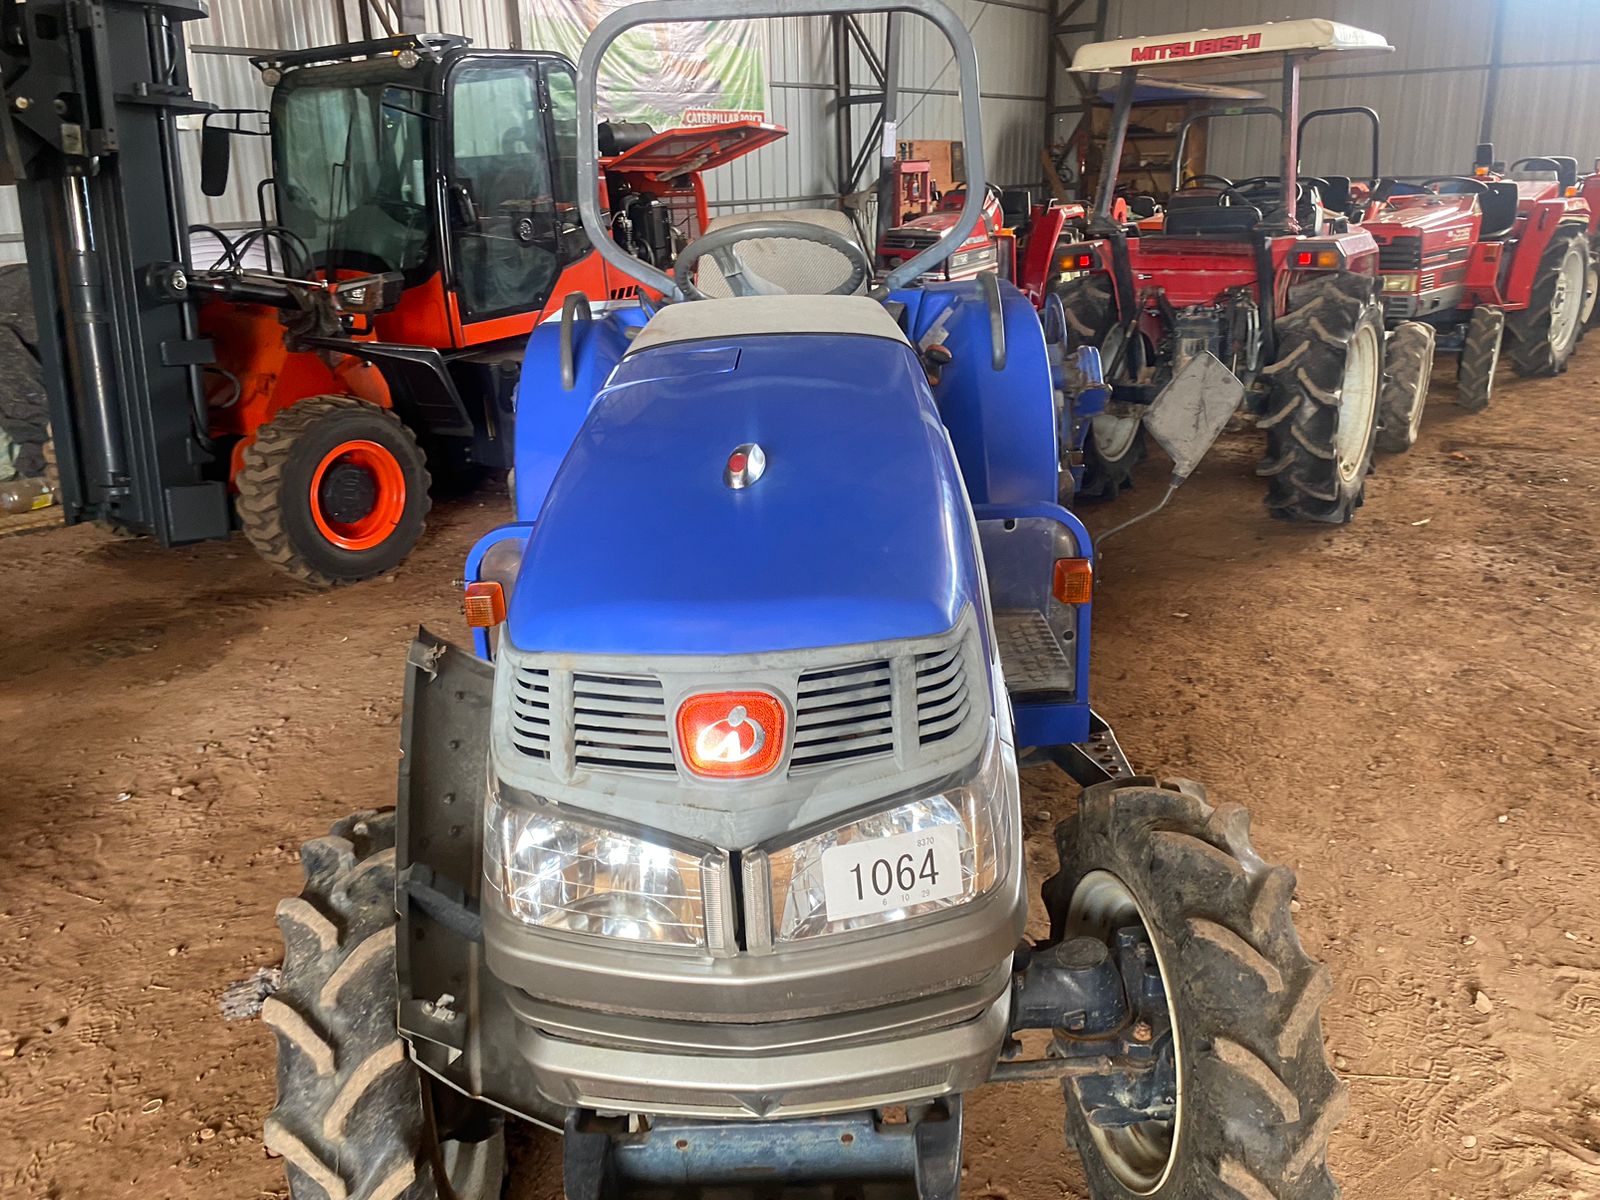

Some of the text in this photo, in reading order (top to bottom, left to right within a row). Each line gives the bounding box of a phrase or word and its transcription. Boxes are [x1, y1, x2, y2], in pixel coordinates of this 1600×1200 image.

[1131, 32, 1262, 62] MITSUBISHI
[686, 112, 739, 124] CATERPILLAR
[917, 836, 934, 848] 8370
[849, 848, 939, 900] 1064
[901, 893, 910, 901] 10
